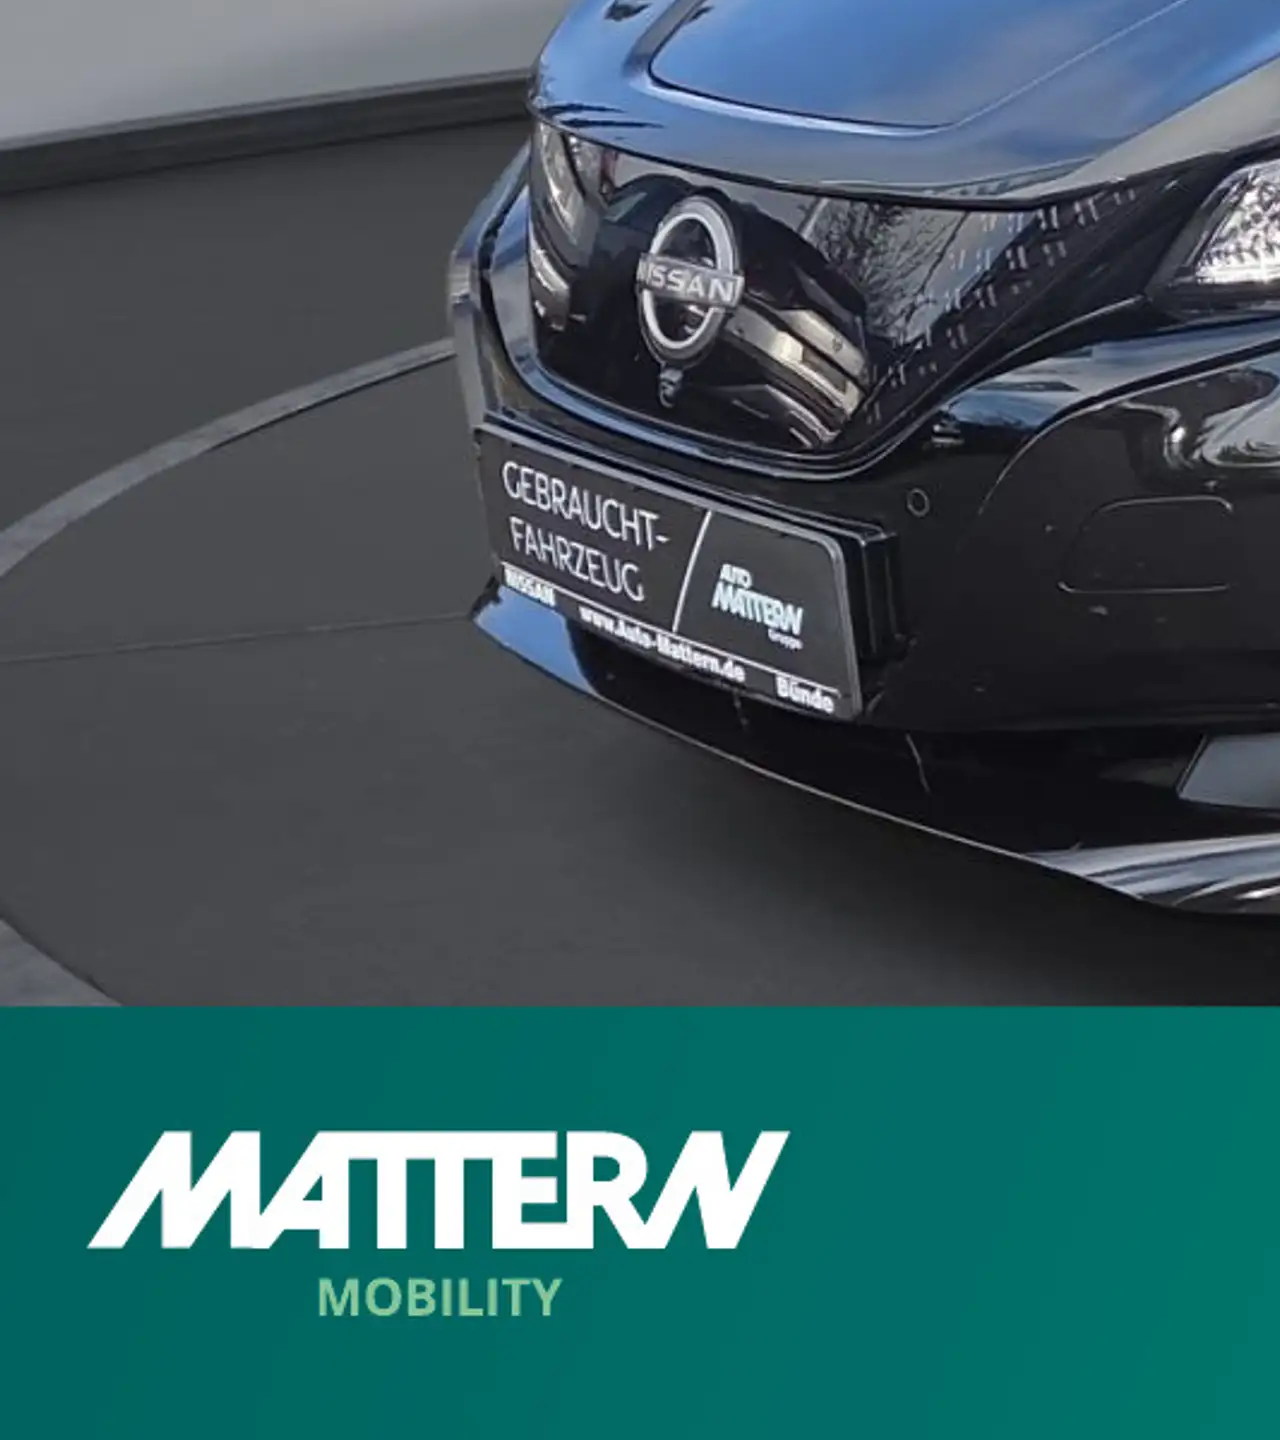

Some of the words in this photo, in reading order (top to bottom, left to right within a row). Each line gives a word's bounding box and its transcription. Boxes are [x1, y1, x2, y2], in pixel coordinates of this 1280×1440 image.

[636, 260, 734, 303] NISSAN
[502, 461, 671, 551] GEBRAUCHT-
[509, 516, 645, 602] FAHRZEUG
[719, 563, 752, 589] AUTO
[711, 581, 803, 636] MATTERN
[578, 605, 746, 683] www.Auto-Mattern.de
[776, 675, 835, 714] Bünde
